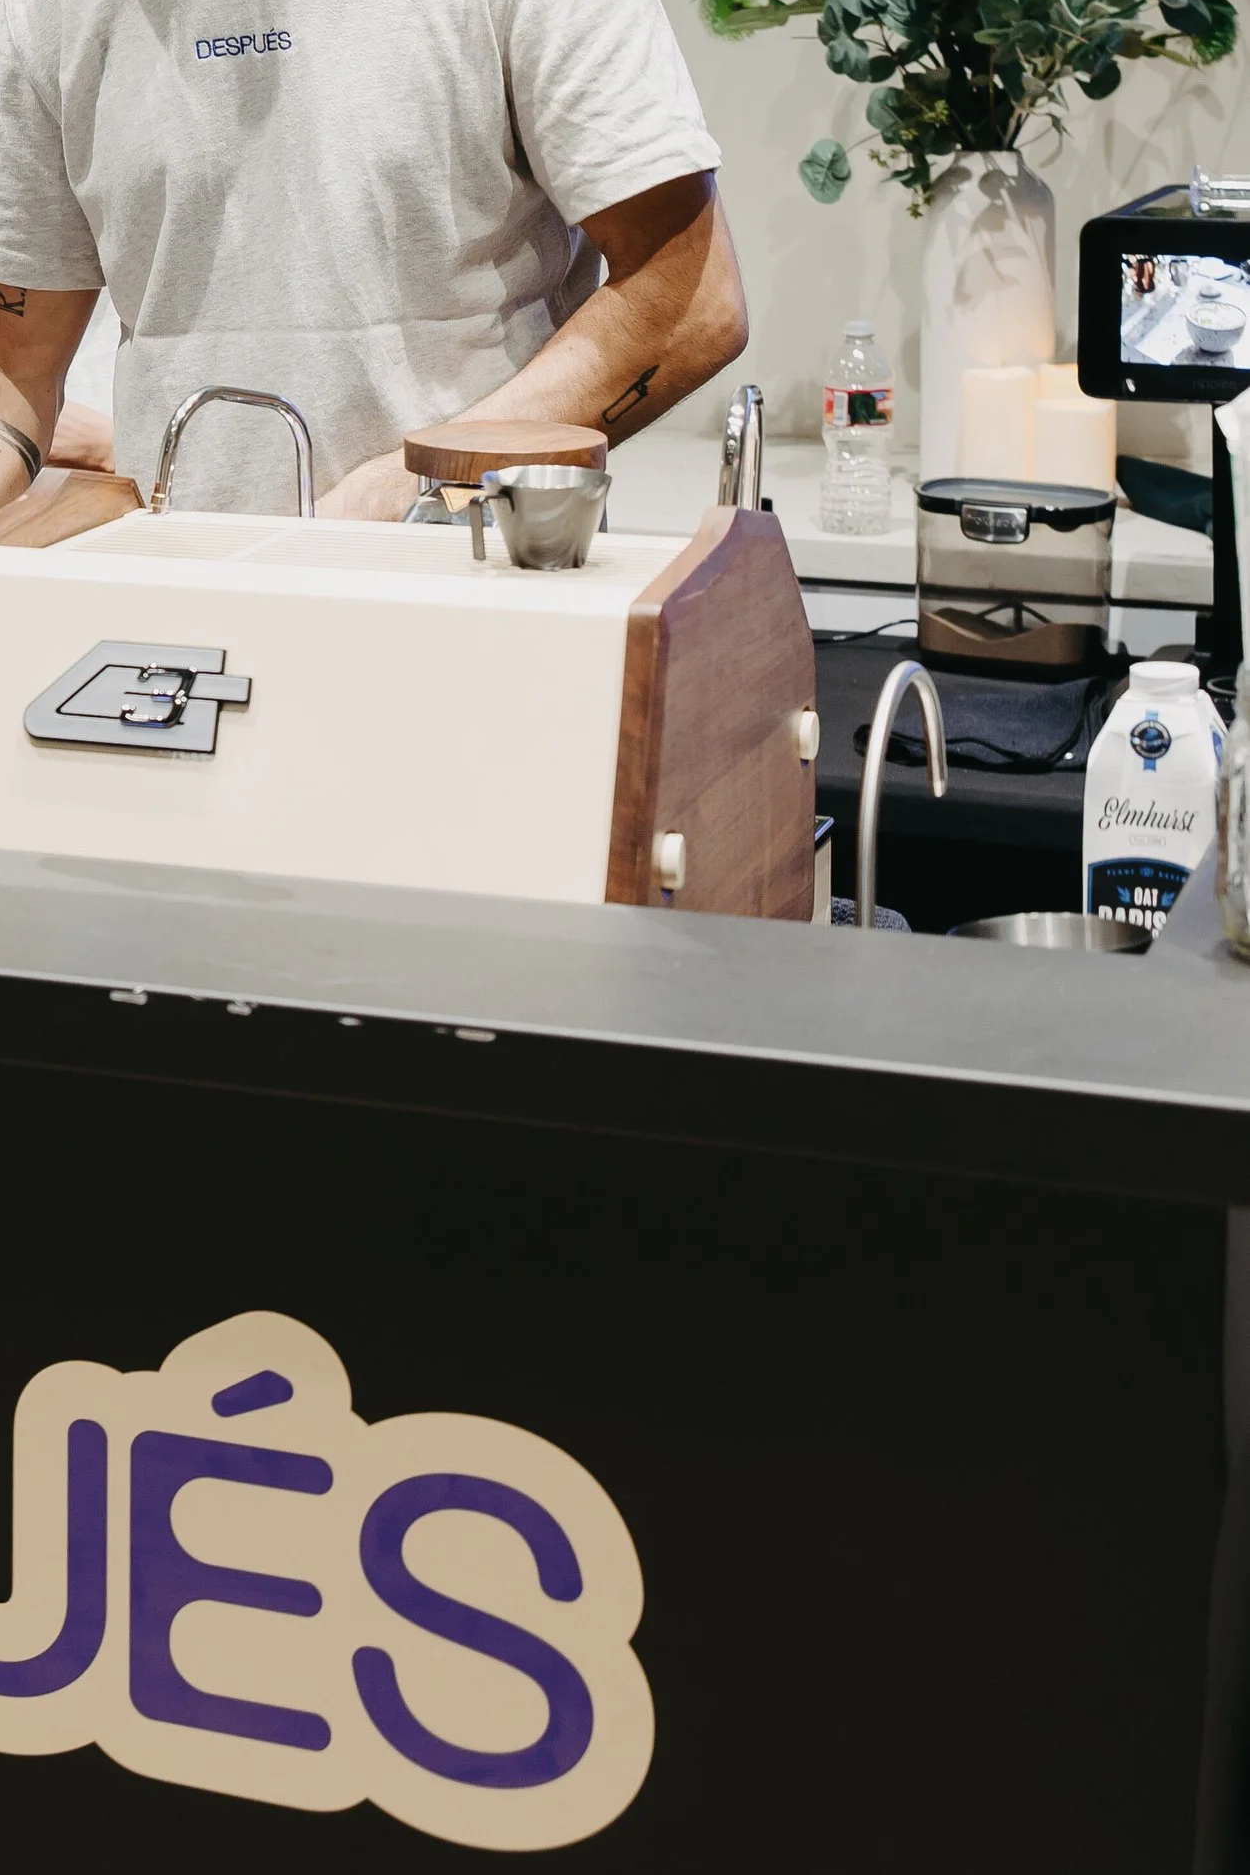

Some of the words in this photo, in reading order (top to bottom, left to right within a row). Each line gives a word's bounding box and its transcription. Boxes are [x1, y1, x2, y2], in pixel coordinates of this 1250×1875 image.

[195, 28, 292, 60] DESPUÉS
[1098, 795, 1199, 834] Elmhurst
[1134, 886, 1159, 907] OAT
